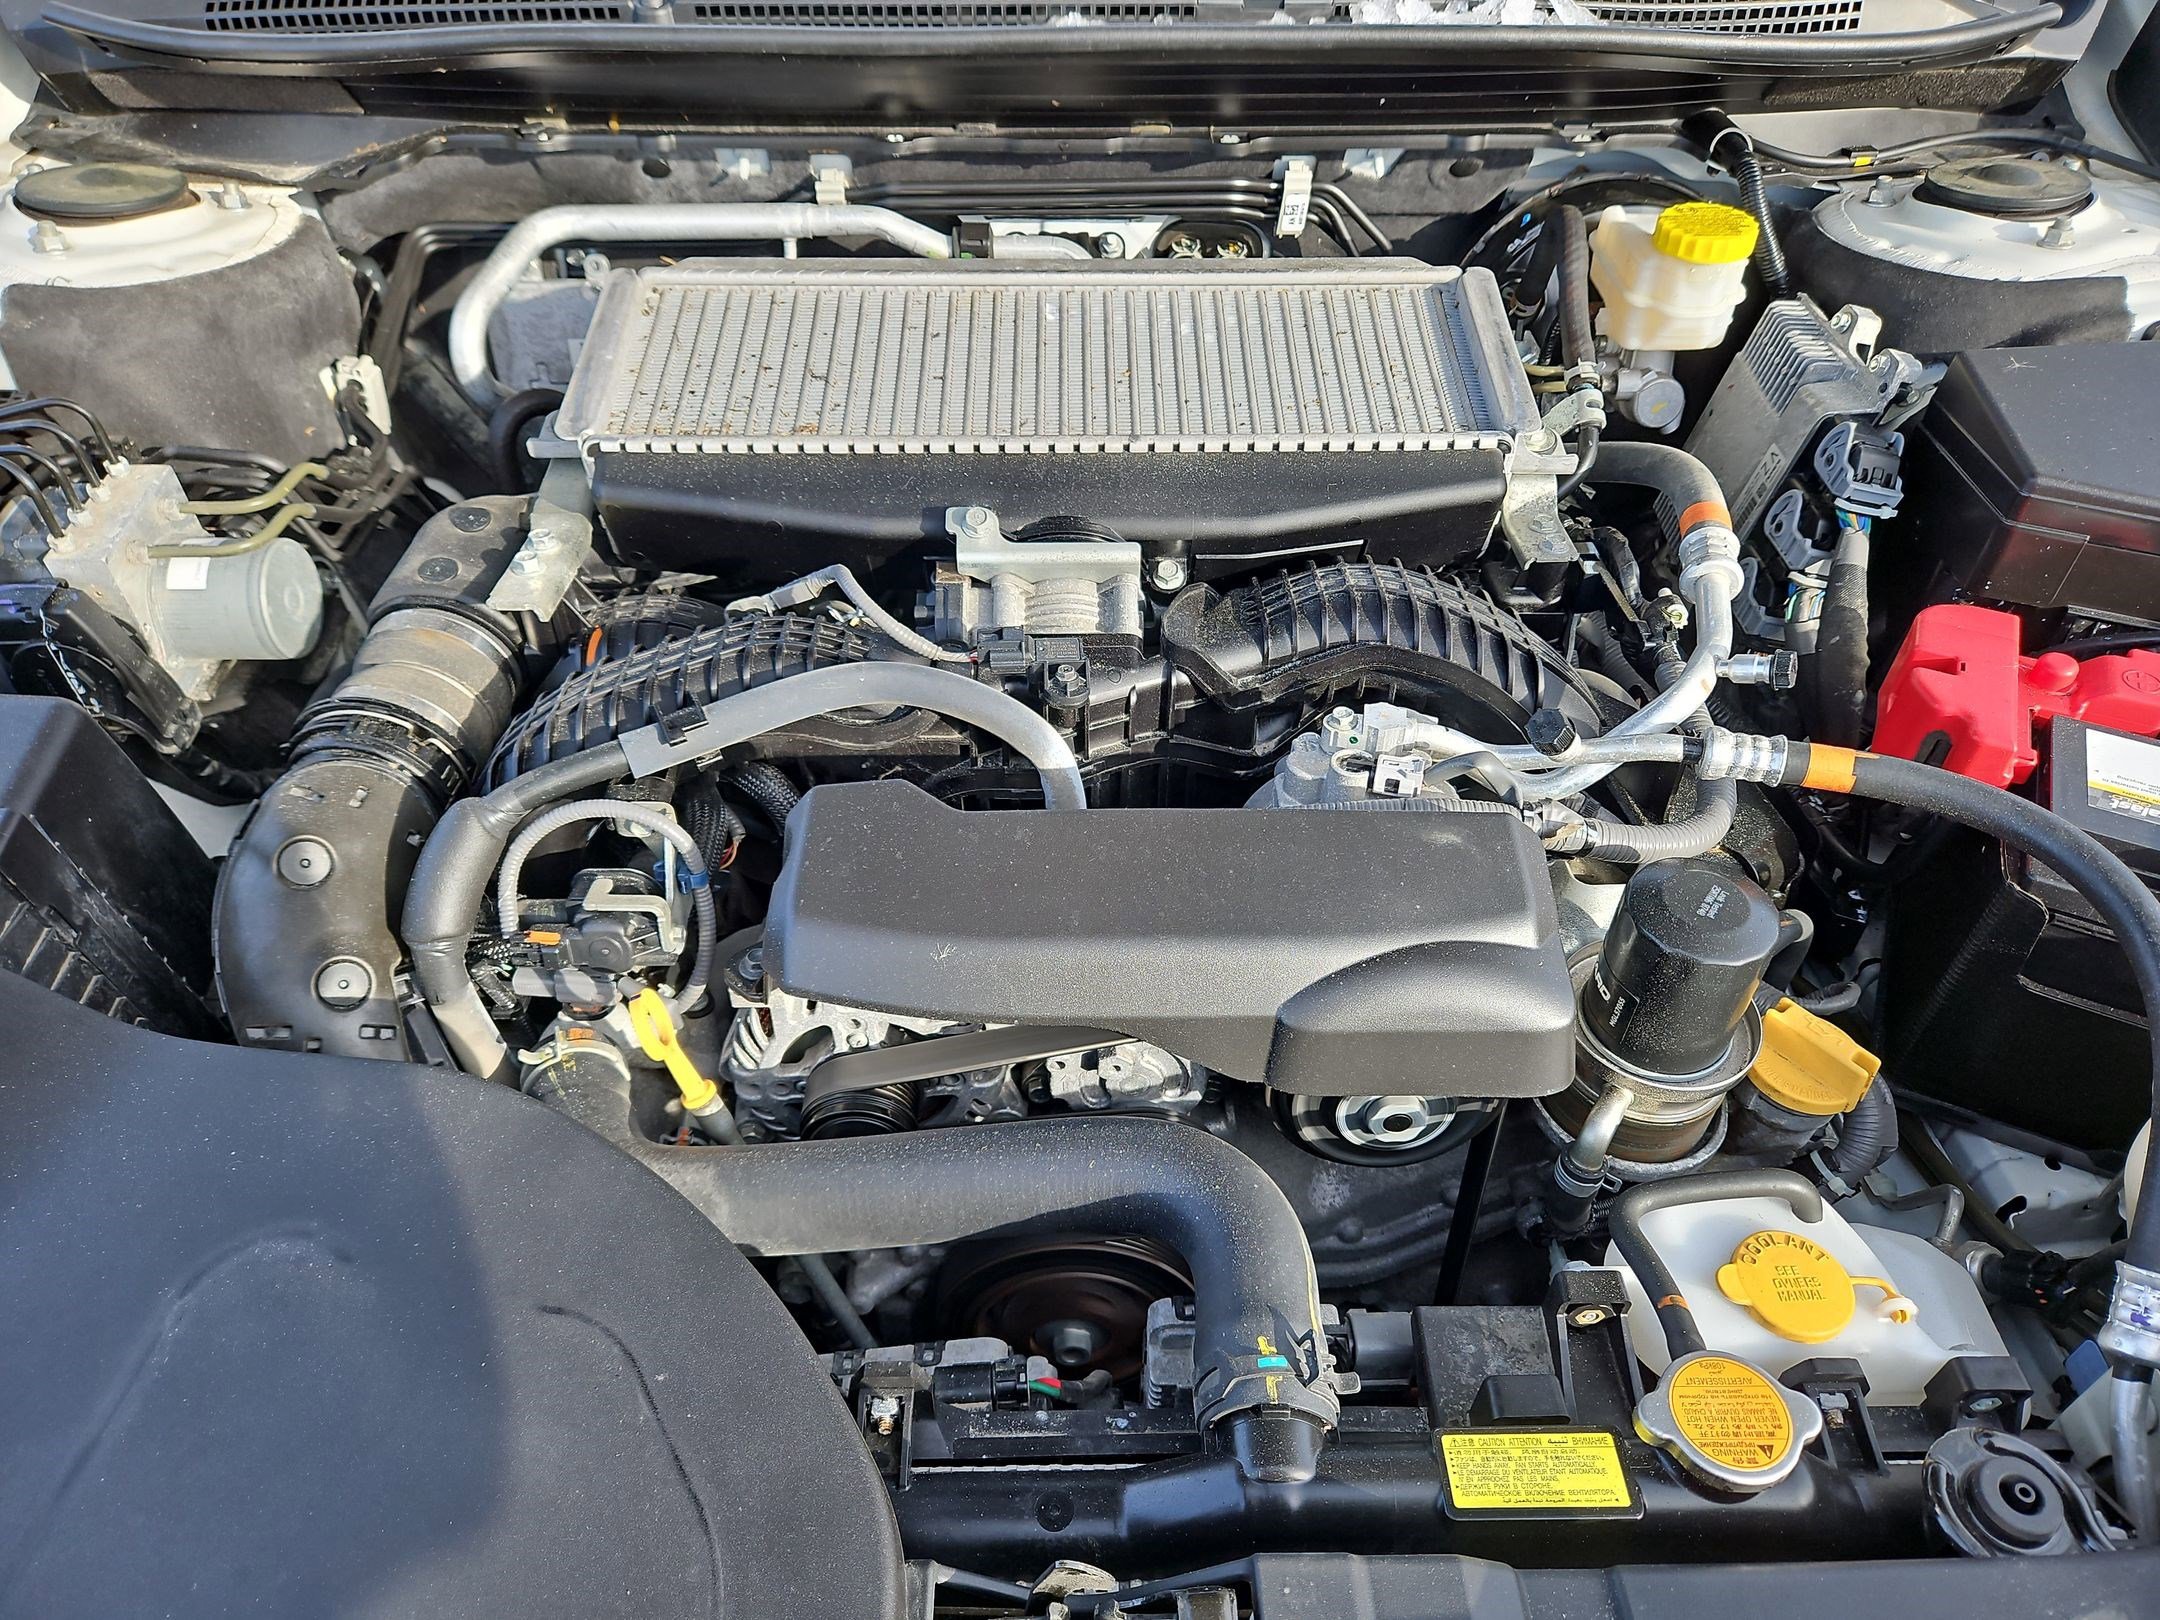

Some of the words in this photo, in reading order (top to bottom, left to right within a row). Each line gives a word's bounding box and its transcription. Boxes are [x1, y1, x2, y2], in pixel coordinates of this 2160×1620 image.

[2109, 798, 2160, 817] alast
[1741, 1233, 1829, 1265] COOLANT
[1775, 1265, 1799, 1276] SEE
[1777, 1290, 1827, 1302] MANUAL
[1685, 1377, 1752, 1385] AVERTISSEMENT
[1479, 1438, 1506, 1447] CAUTION
[1509, 1438, 1542, 1447] ATTENTION
